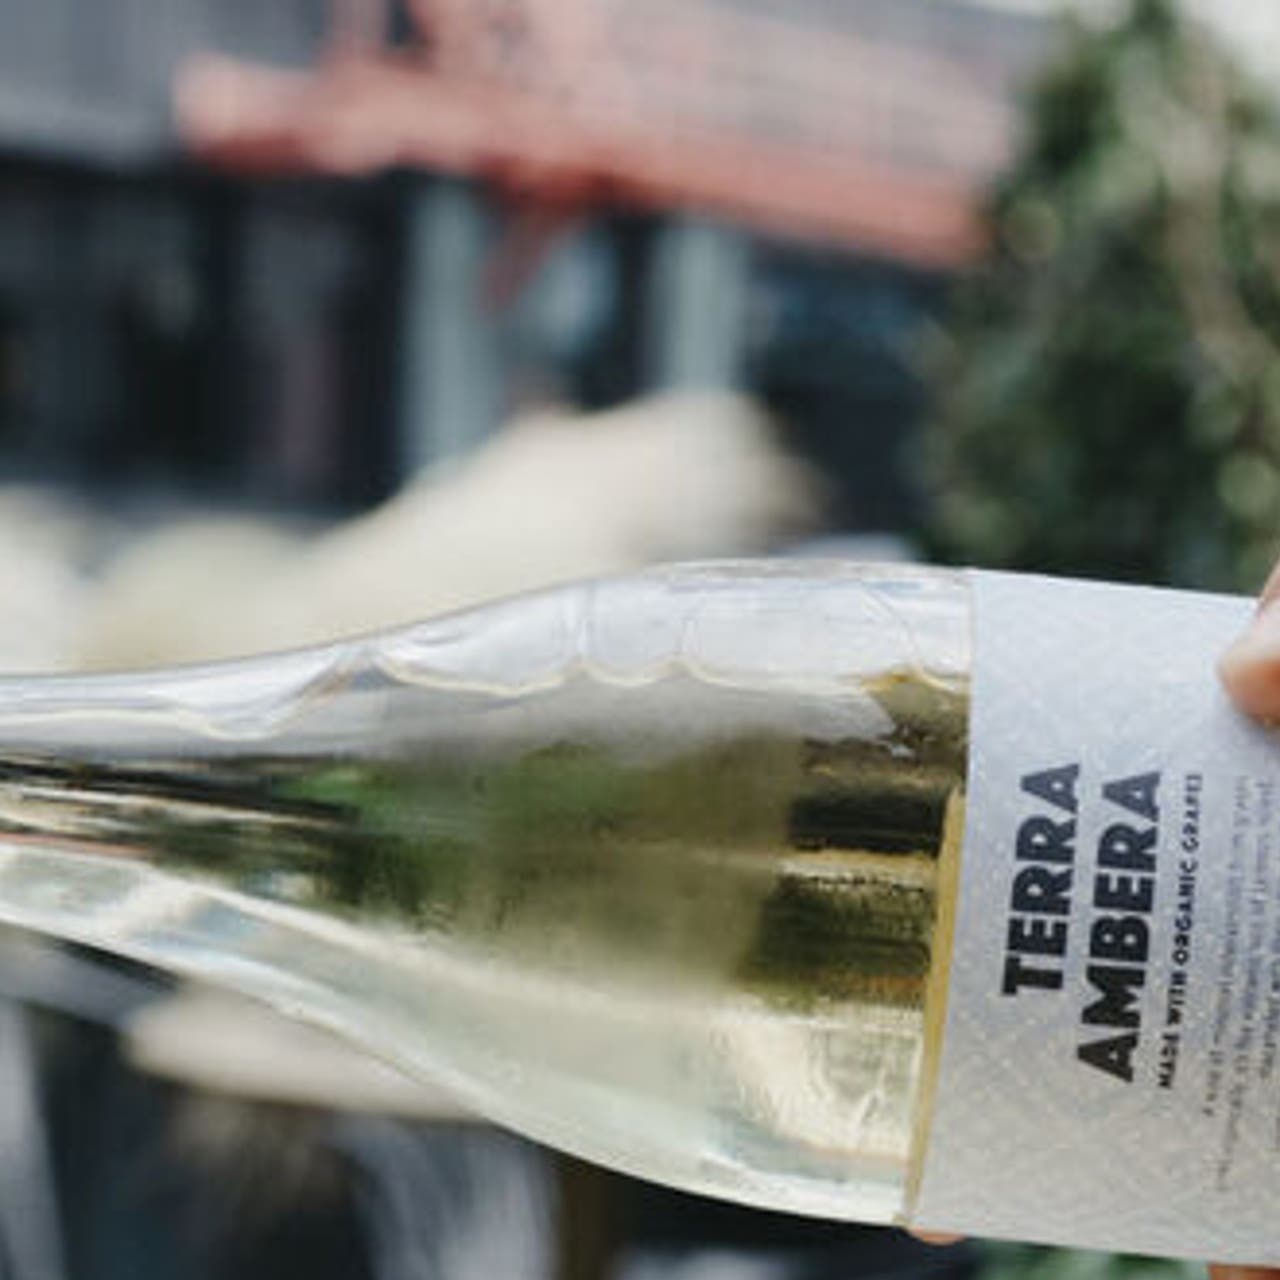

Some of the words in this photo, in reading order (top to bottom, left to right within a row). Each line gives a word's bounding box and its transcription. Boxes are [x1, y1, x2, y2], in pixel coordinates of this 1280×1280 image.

[1181, 773, 1203, 850] GRAPES
[1001, 763, 1080, 996] TERRA
[1172, 860, 1198, 965] ORGANIC
[1077, 771, 1162, 1083] AMBERA
[1167, 972, 1188, 1026] WITH
[1158, 1033, 1180, 1090] MADE
